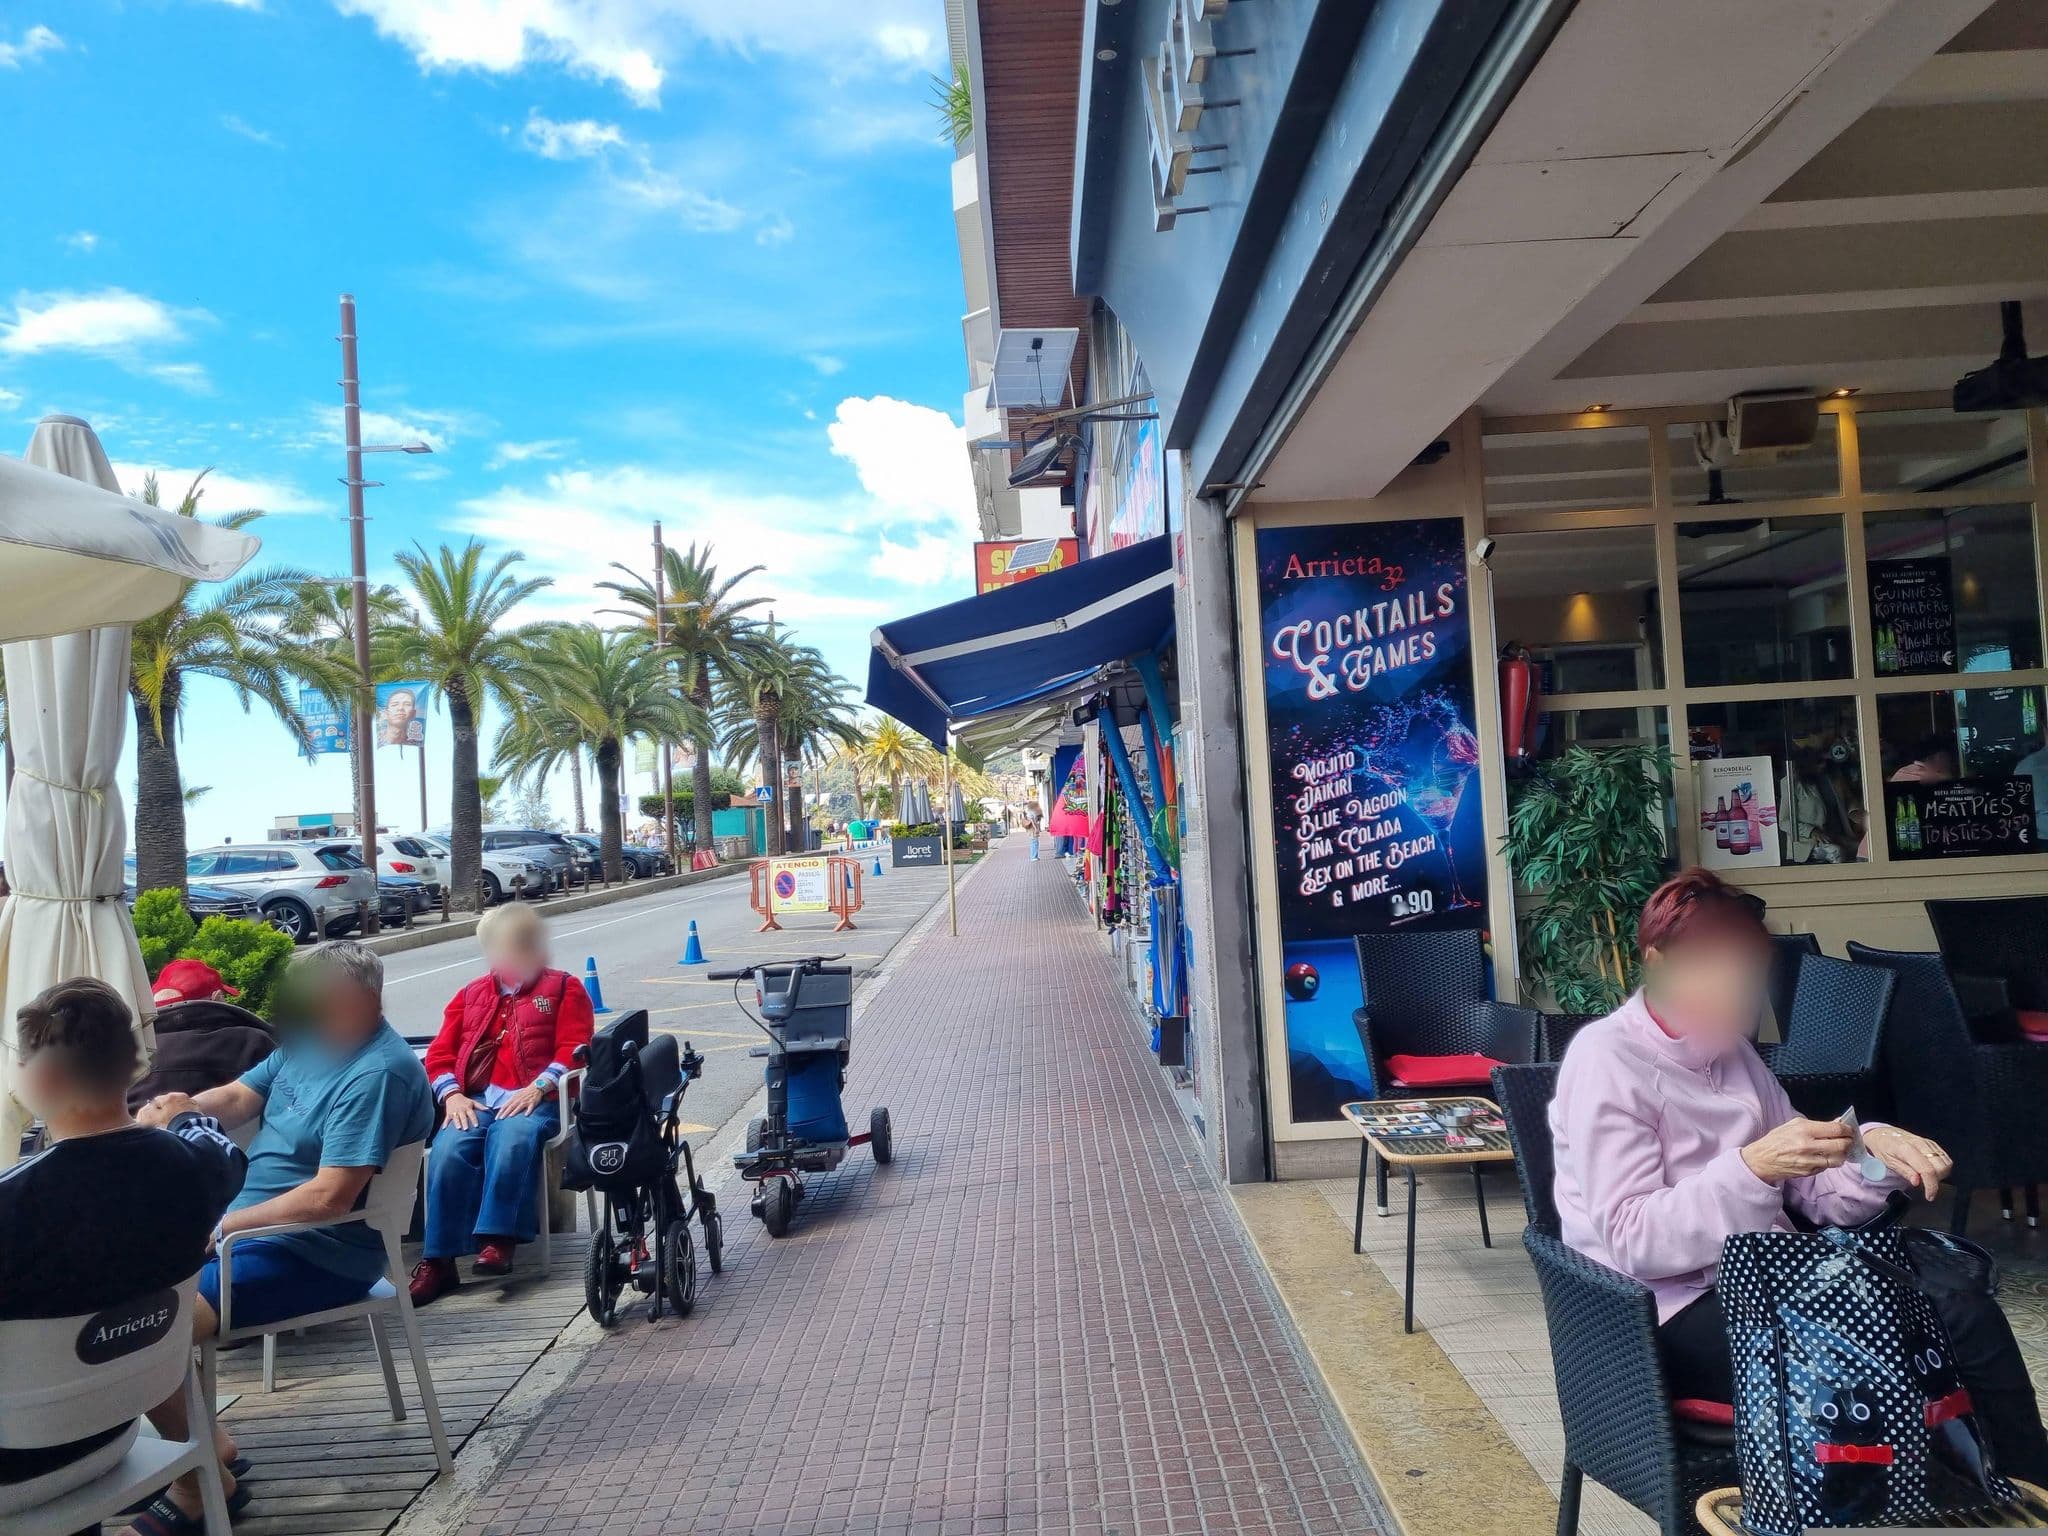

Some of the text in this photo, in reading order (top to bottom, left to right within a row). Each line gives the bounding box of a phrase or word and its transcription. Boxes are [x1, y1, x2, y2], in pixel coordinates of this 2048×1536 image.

[991, 548, 1064, 576] SUR
[1282, 552, 1406, 591] Arrieta 32
[1874, 583, 1942, 600] GUINNESS
[1273, 583, 1455, 672] COCKTAILS
[1307, 631, 1436, 700] & GAMES
[1293, 751, 1355, 785] MOJITO
[1295, 777, 1352, 814] DAIKIRI
[1296, 788, 1408, 841] BLUE LAGOON
[907, 845, 932, 855] lloret
[1298, 817, 1402, 870] PIÑA COLADA
[1300, 834, 1436, 895] SEX ON THE BEACH
[1333, 874, 1402, 907] & MORE...
[600, 1157, 618, 1167] GO
[601, 1148, 619, 1158] SIT
[92, 1314, 155, 1345] Arrieta
